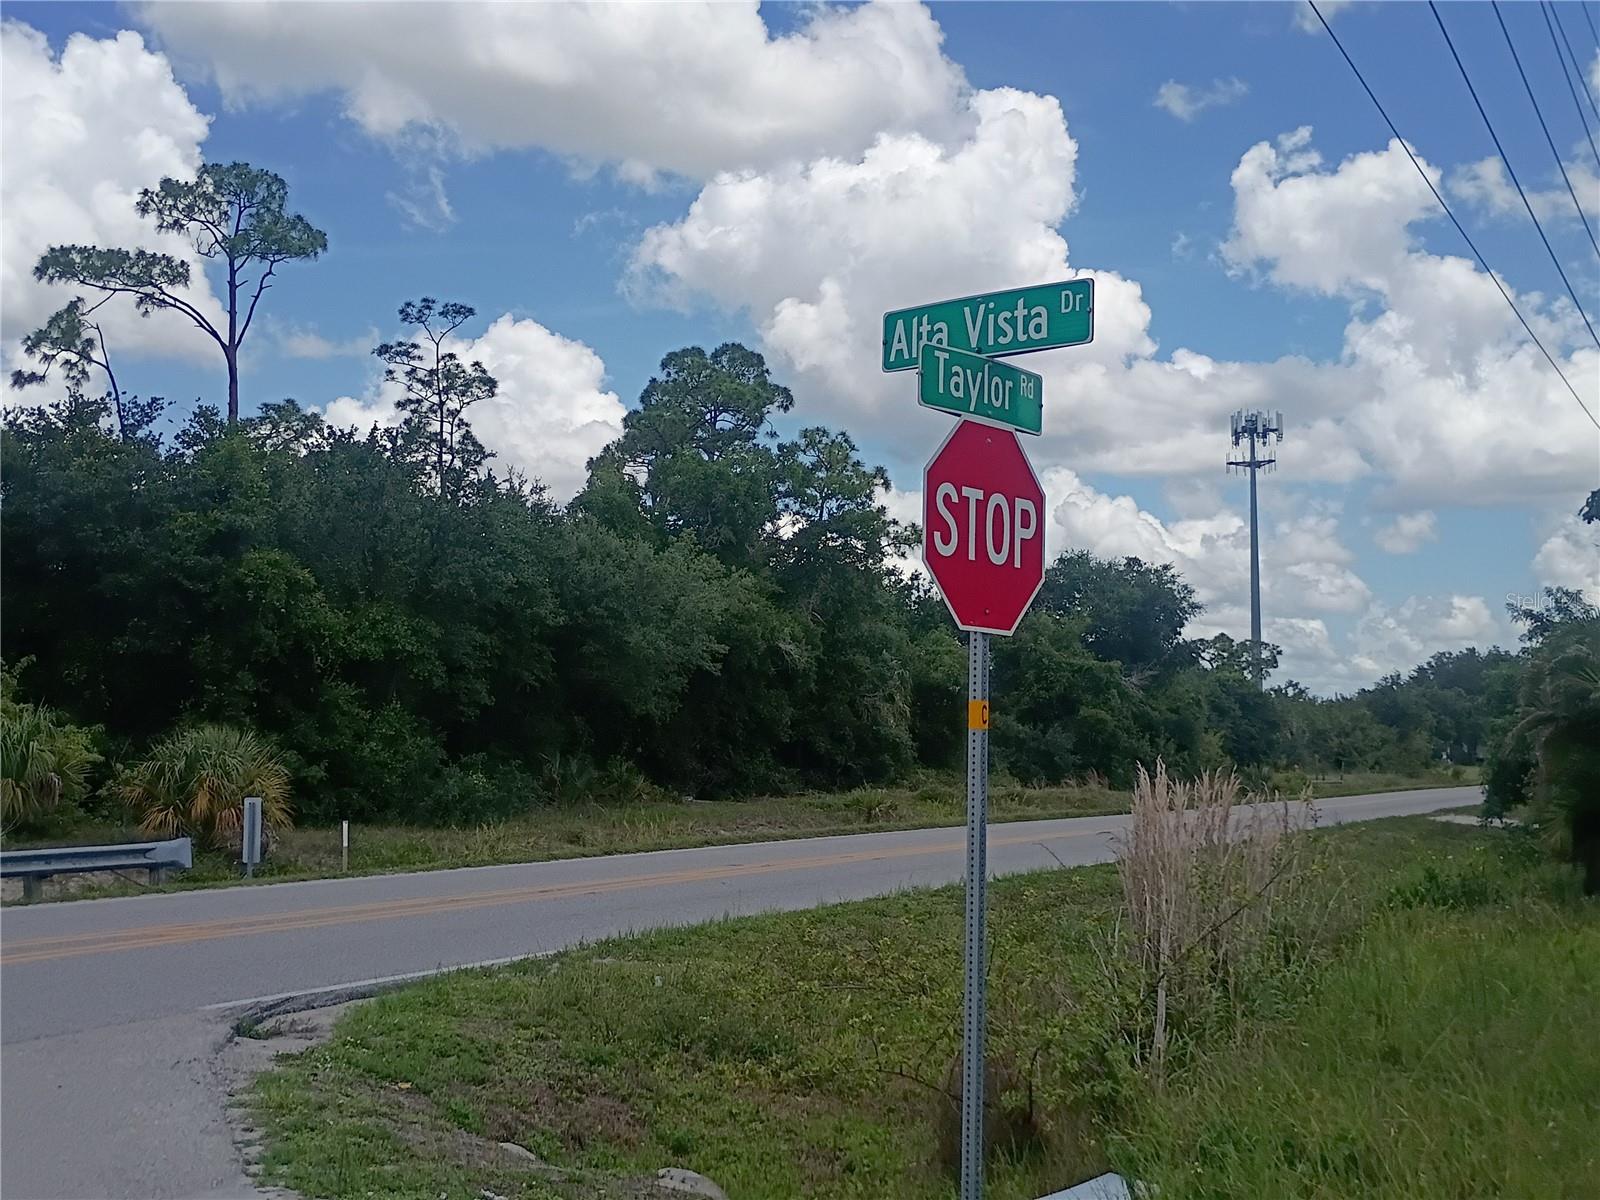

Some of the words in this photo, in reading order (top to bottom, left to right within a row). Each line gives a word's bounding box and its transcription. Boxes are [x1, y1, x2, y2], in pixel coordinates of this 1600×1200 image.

[889, 314, 949, 362] Alta
[963, 298, 1048, 349] Vista
[1060, 290, 1083, 314] Dr
[934, 350, 1013, 411] Taylor
[1020, 374, 1034, 400] Rd
[933, 482, 1037, 569] STOP
